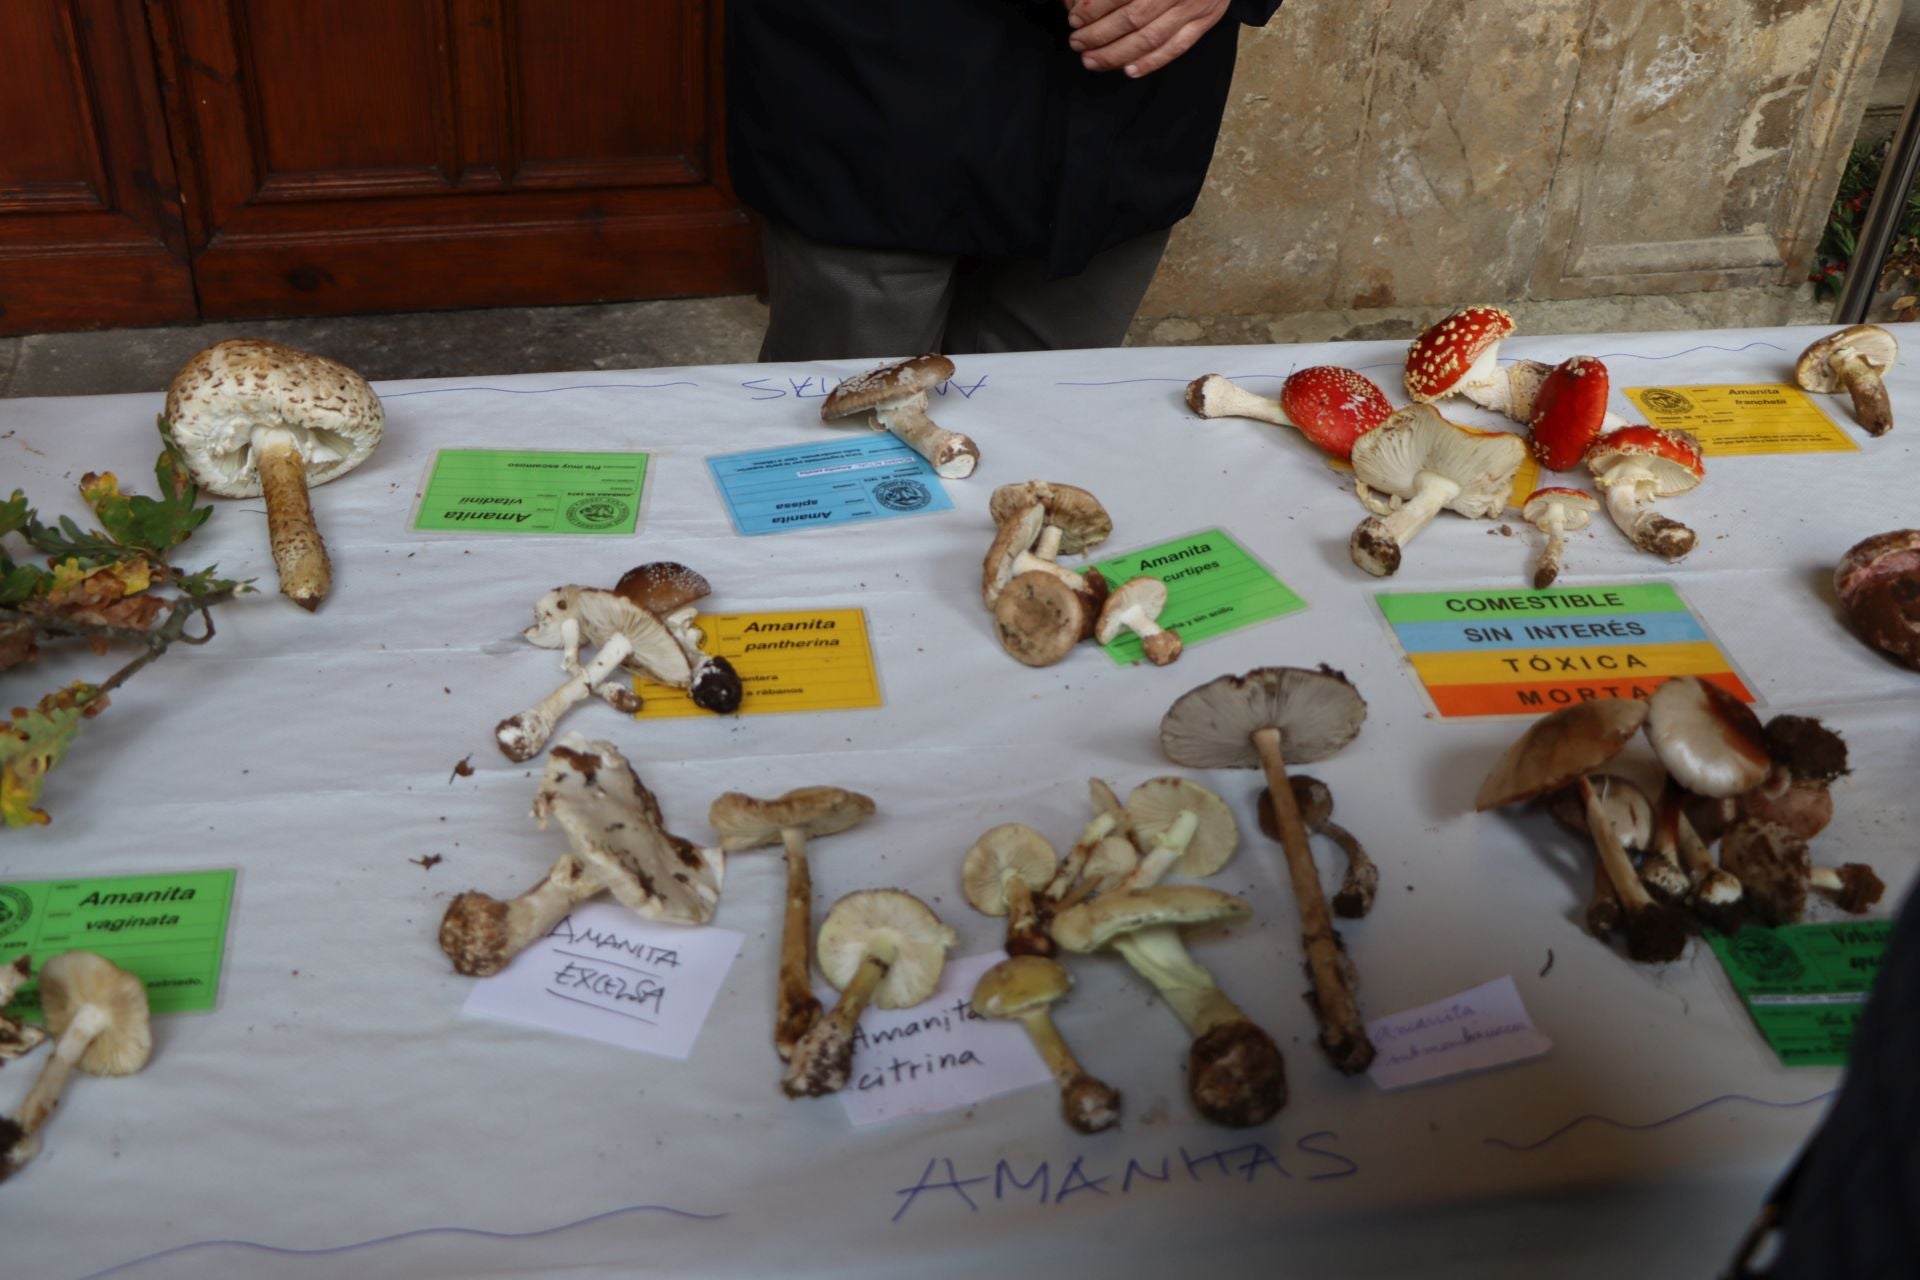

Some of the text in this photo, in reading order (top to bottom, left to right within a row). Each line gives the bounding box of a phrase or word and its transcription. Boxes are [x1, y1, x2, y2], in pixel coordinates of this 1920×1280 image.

[1728, 388, 1780, 396] Amanita
[458, 496, 523, 505] vitadinii
[775, 499, 819, 510] spissa
[444, 510, 533, 523] Amanita
[772, 511, 833, 524] Amanita
[1139, 541, 1212, 571] Amanita
[1162, 560, 1220, 584] curtipes
[1445, 593, 1625, 614] COMESTIBLE
[743, 618, 837, 633] Amanita
[1463, 620, 1647, 643] SIN INTERÉS
[744, 637, 840, 653] pantherina
[1502, 653, 1648, 674] TÓXICA
[741, 674, 778, 682] antera
[1516, 685, 1652, 706] MORTA
[78, 886, 197, 908] Amanita
[86, 913, 181, 933] vaginata
[549, 914, 682, 968] AMANITA
[852, 998, 987, 1050] Amanita
[858, 1049, 984, 1091] citrina
